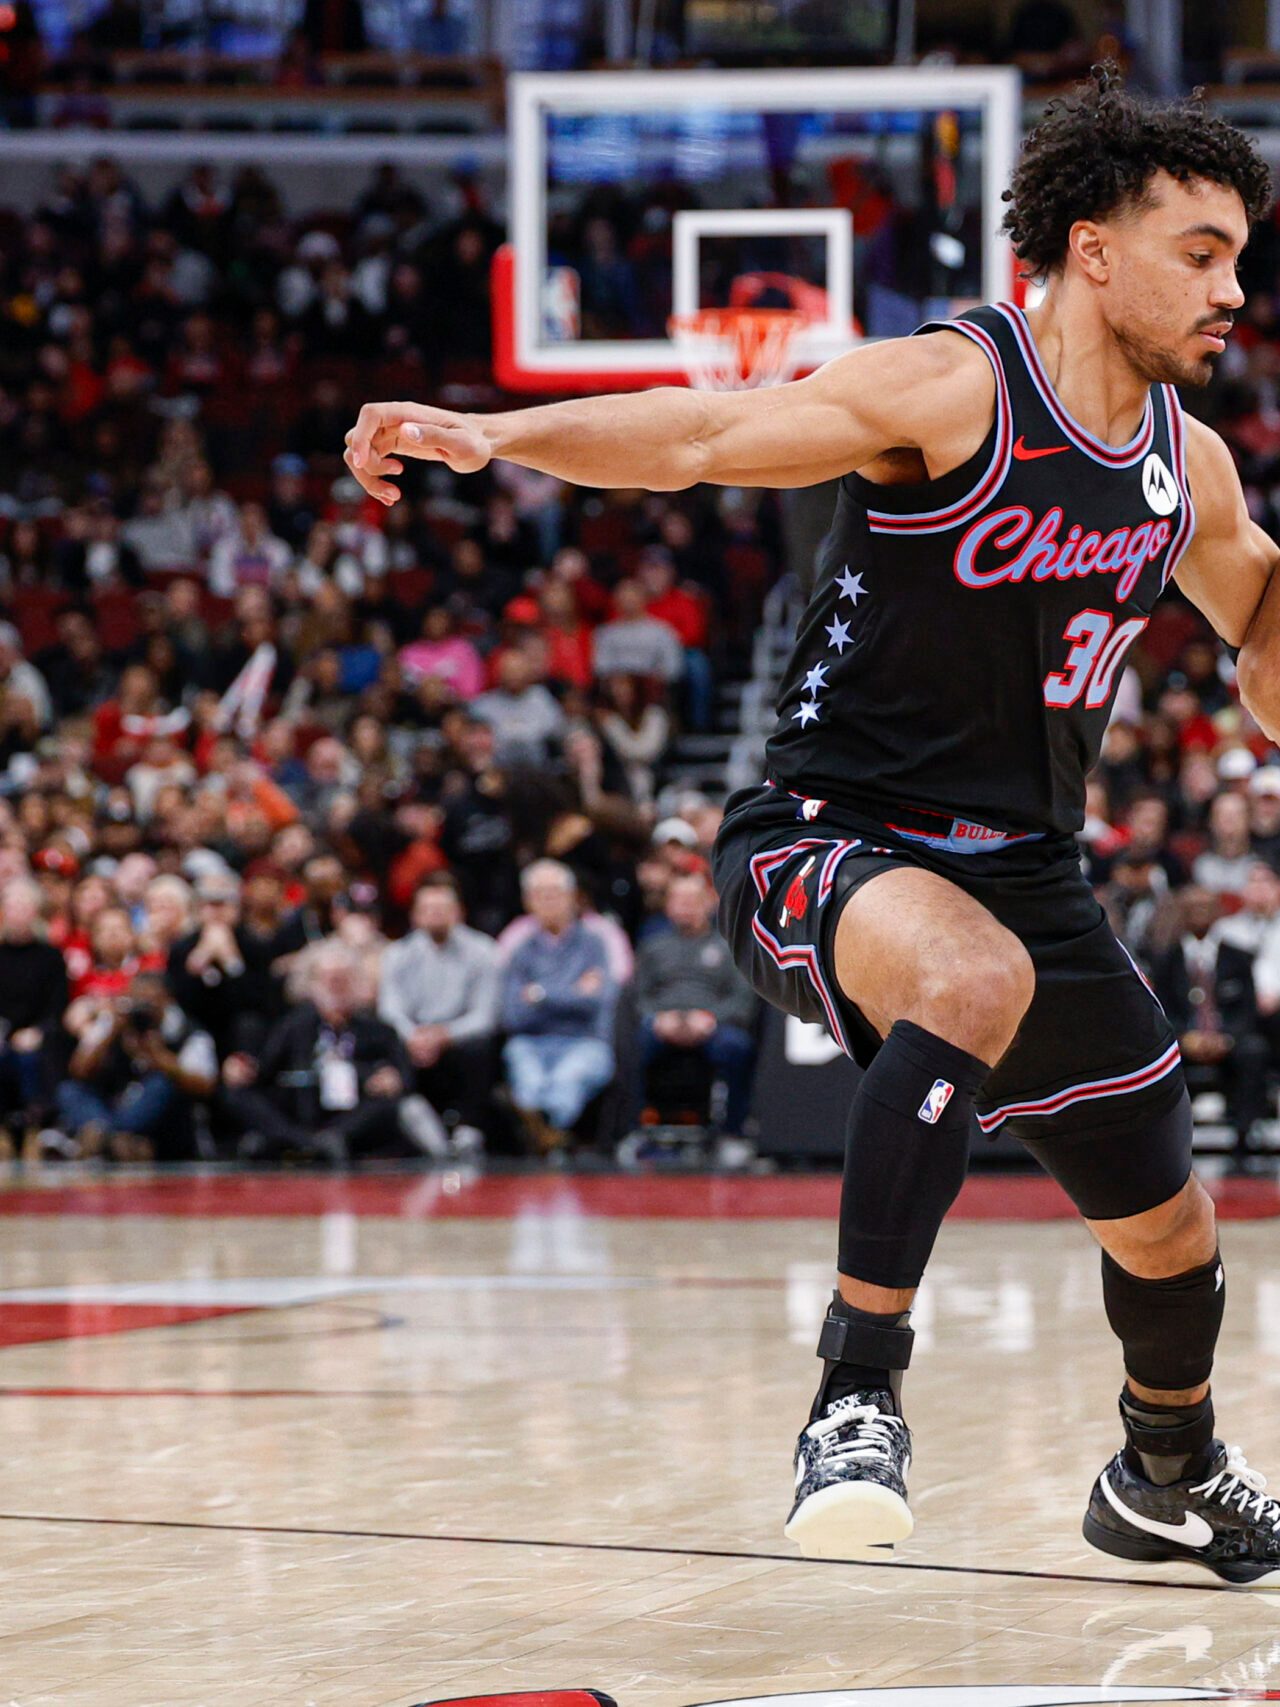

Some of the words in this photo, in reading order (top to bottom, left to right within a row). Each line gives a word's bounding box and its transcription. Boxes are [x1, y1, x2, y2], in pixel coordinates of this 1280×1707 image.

[954, 505, 1172, 603] Chicago
[1043, 608, 1150, 710] 30
[826, 1393, 862, 1416] BOOK
